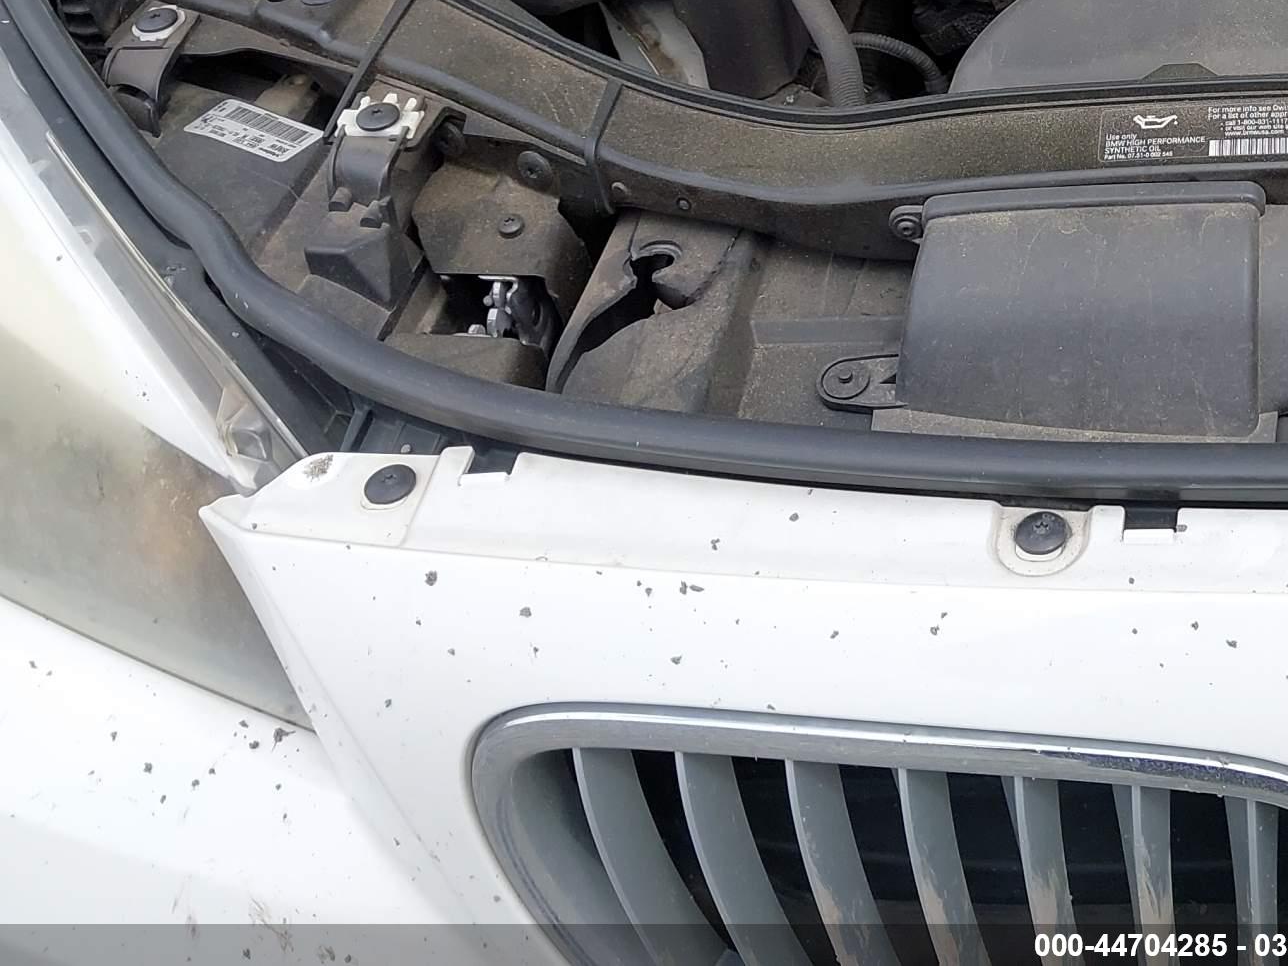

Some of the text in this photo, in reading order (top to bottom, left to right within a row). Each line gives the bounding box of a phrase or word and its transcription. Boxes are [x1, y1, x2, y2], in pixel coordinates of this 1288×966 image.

[1208, 106, 1220, 114] For
[1208, 113, 1220, 121] For
[1106, 133, 1137, 141] Use only
[1105, 136, 1206, 148] BMW HIGH PERFORMANCE
[1105, 146, 1148, 154] SYNTHETIC
